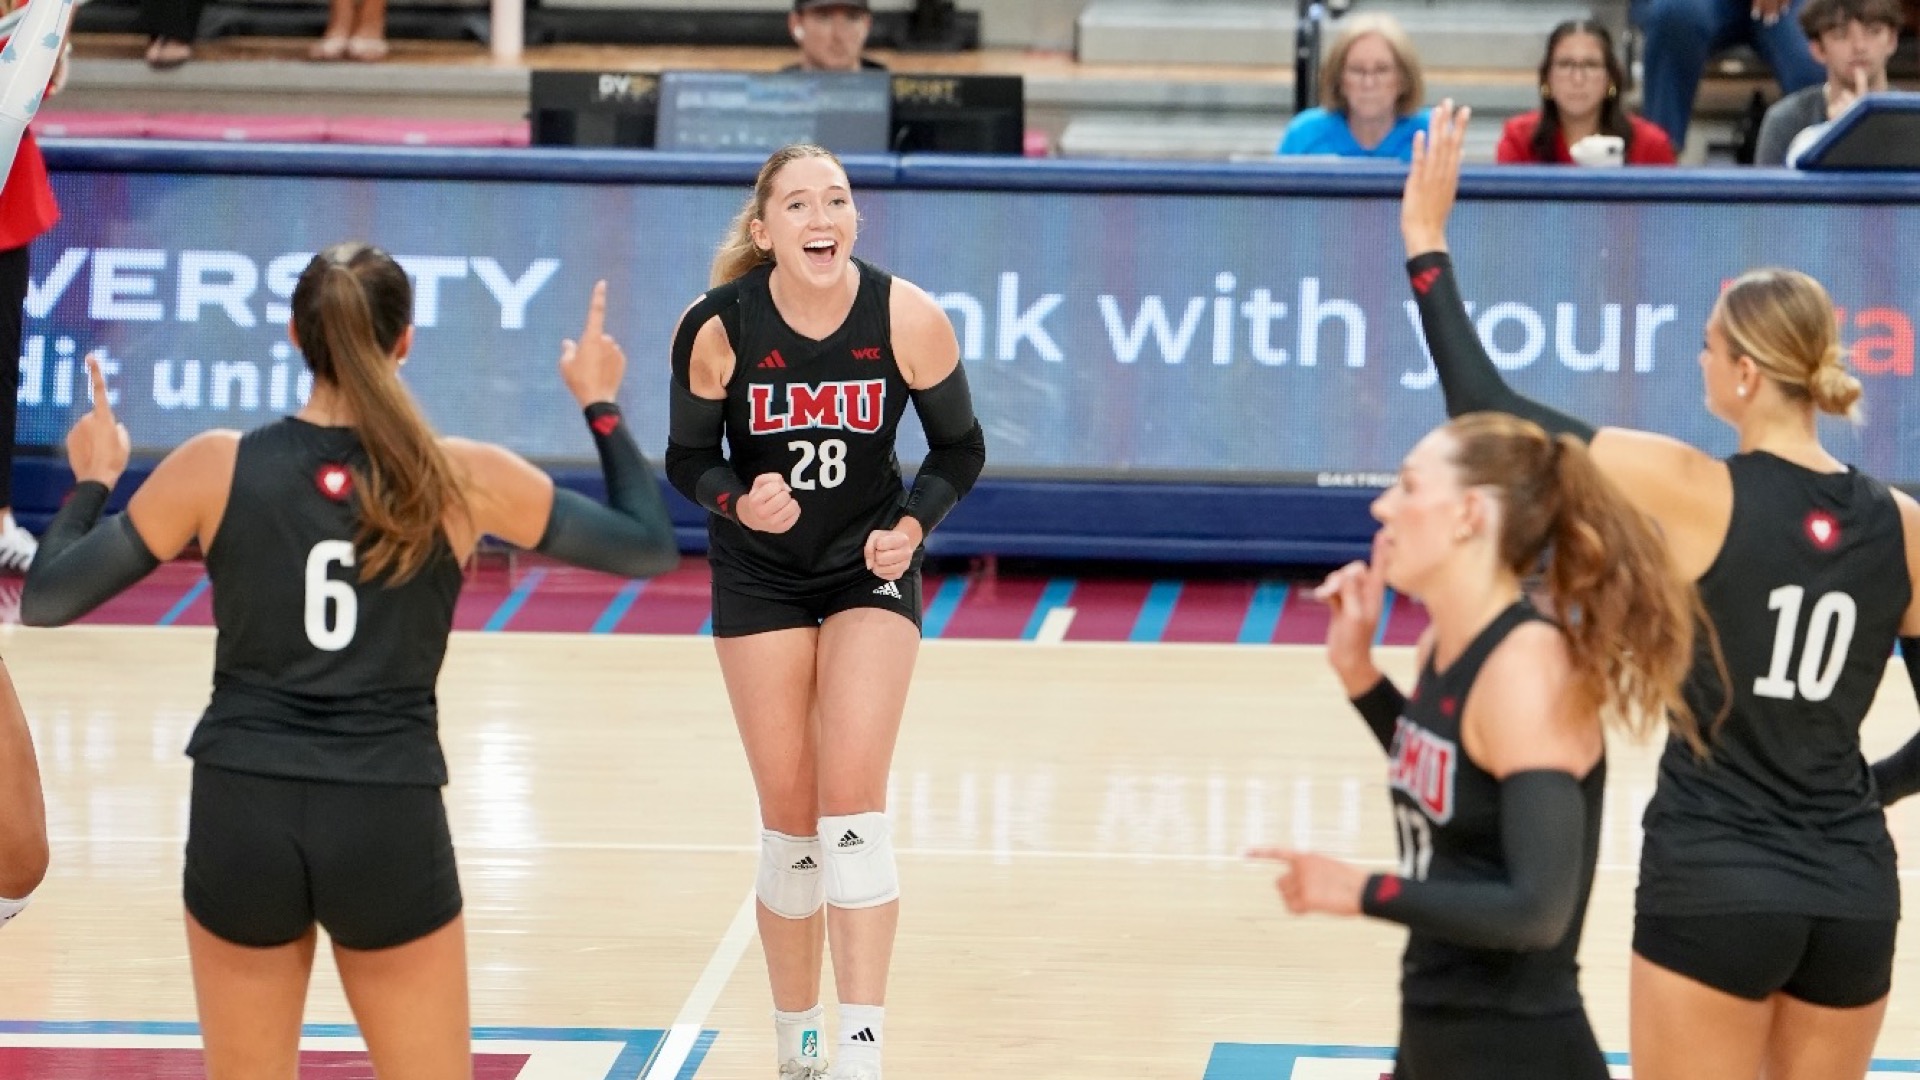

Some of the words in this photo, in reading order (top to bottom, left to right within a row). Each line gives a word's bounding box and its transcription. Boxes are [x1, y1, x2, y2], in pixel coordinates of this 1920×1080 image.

[22, 248, 560, 329] VERSTY
[851, 347, 880, 359] WCC
[1097, 271, 1366, 367] with
[1400, 299, 1678, 389] your
[152, 342, 314, 412] uni
[748, 378, 886, 435] LMU
[788, 439, 847, 490] 28
[304, 540, 358, 651] 6
[1753, 584, 1857, 701] 10
